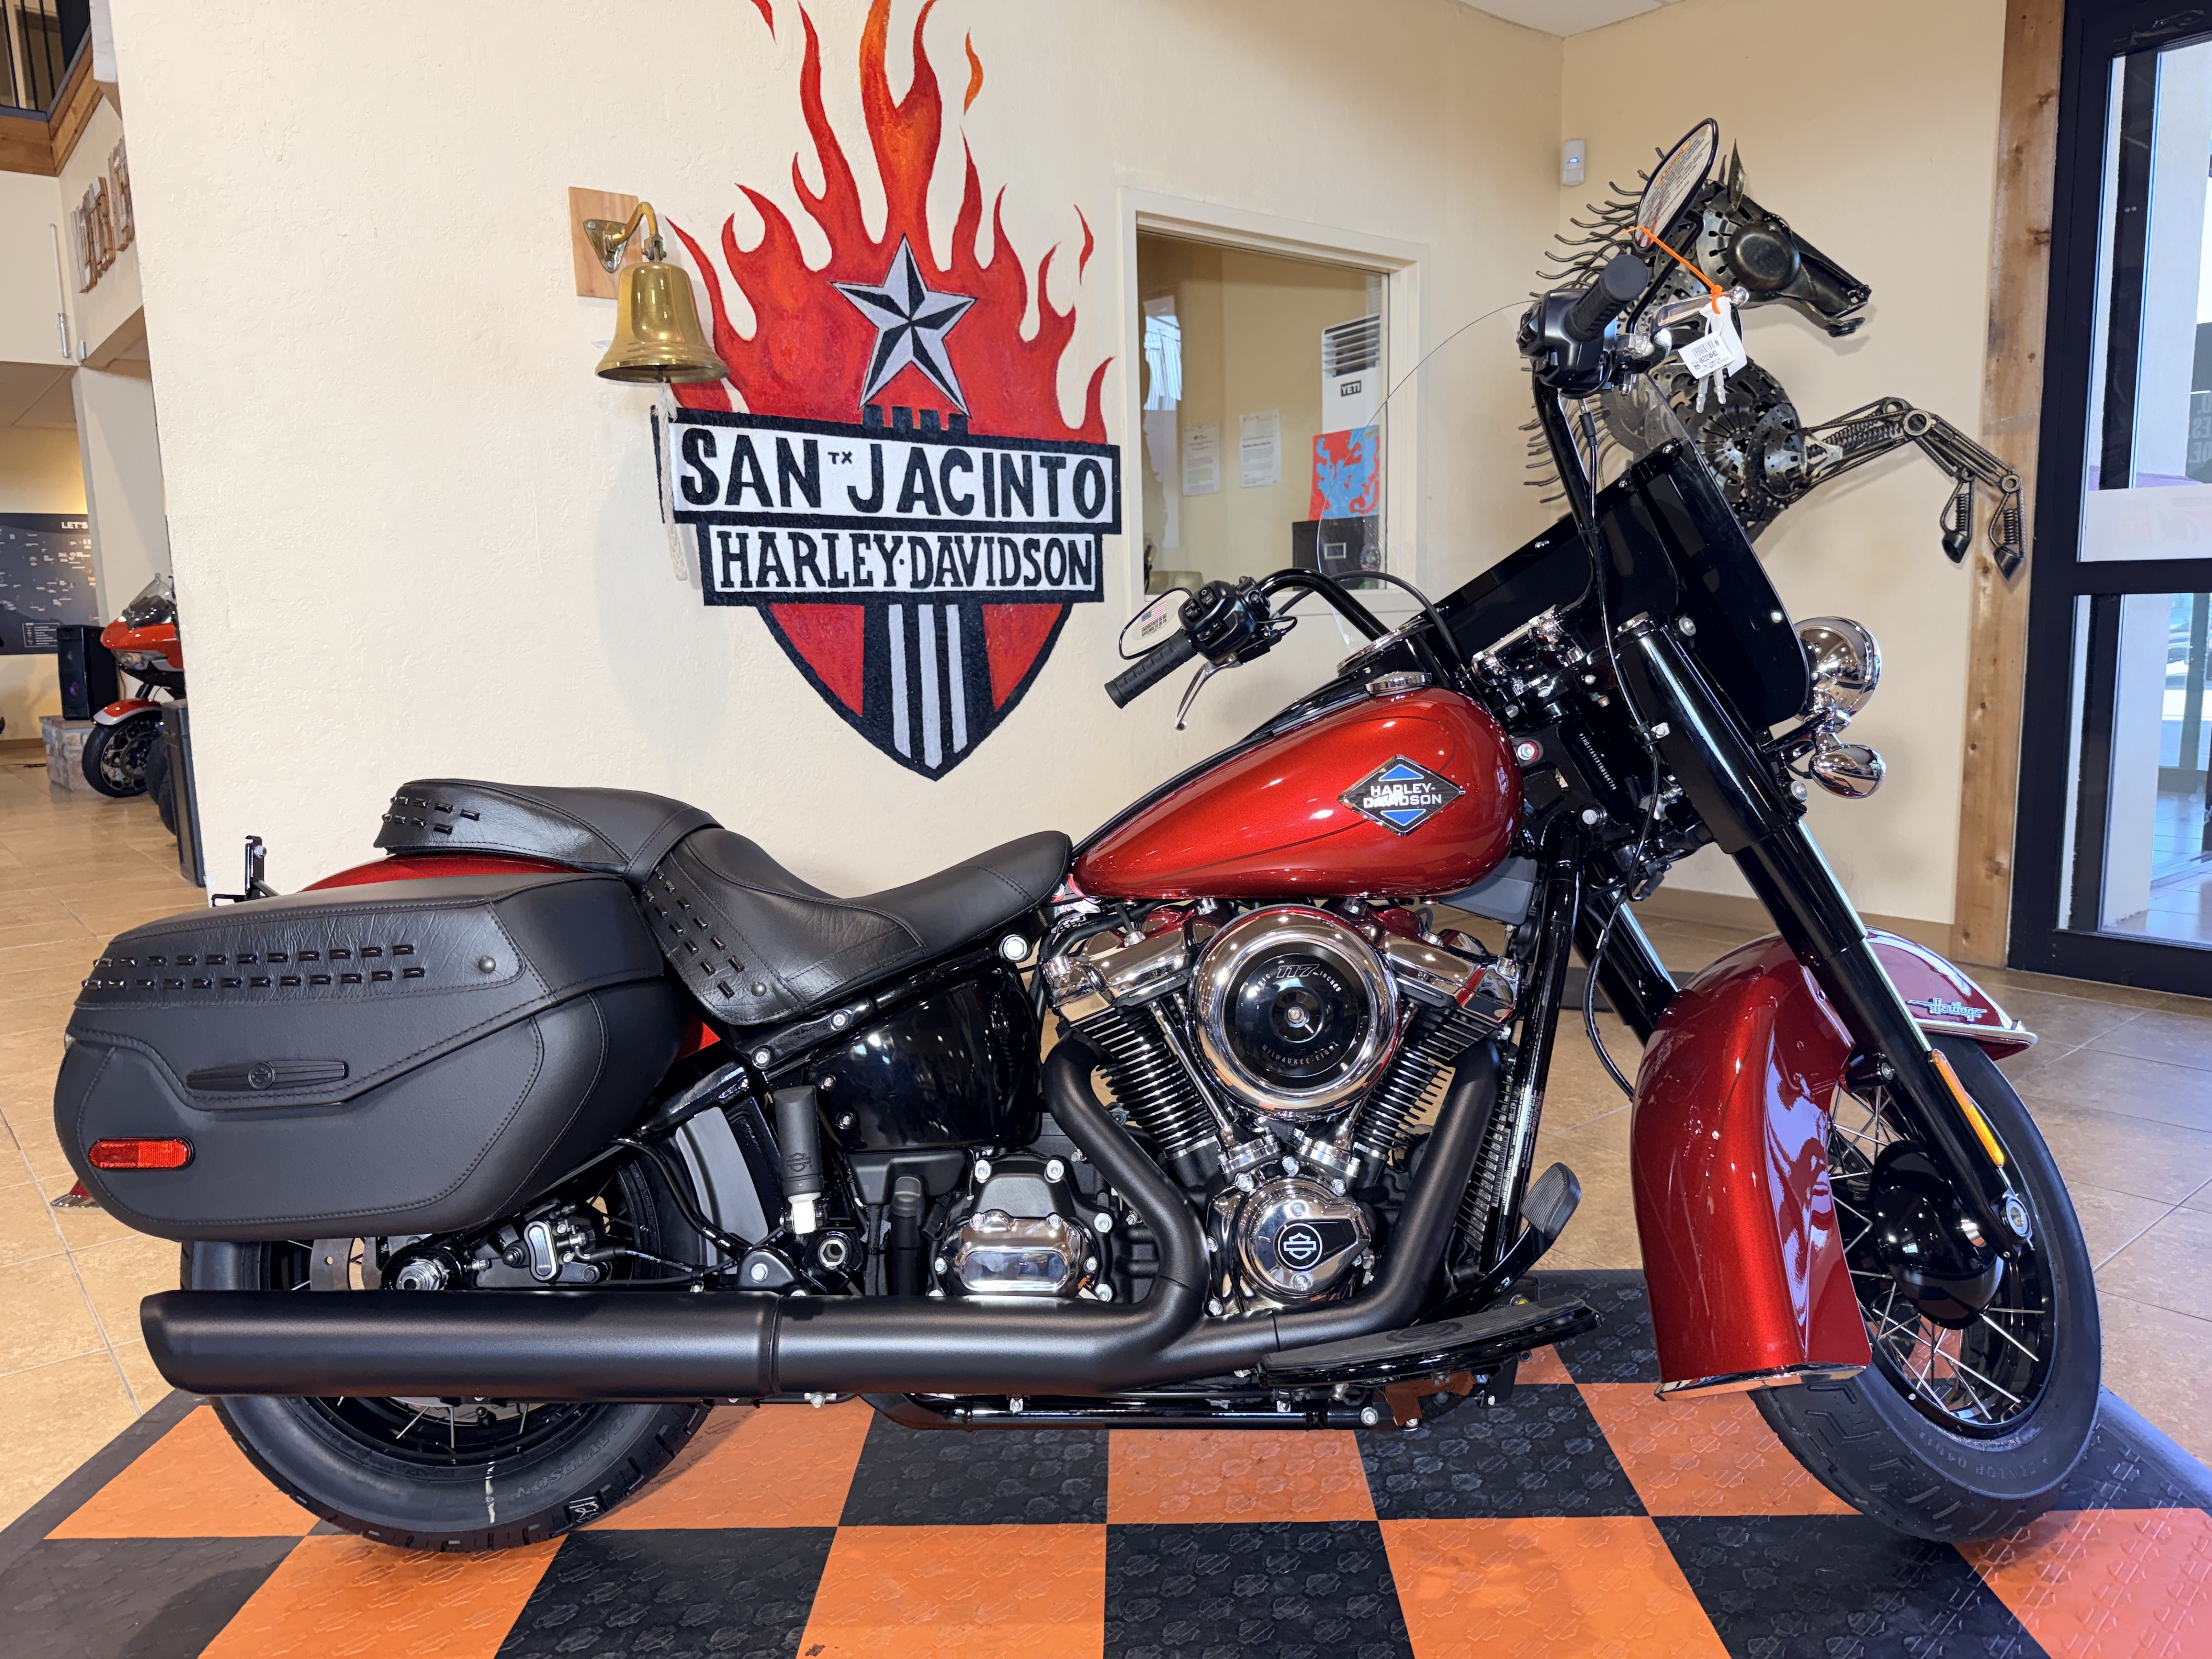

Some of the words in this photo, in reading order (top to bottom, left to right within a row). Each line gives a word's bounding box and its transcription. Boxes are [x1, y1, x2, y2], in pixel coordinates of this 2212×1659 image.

[1341, 382, 1360, 394] YETI
[680, 428, 821, 508] SAN
[828, 451, 853, 465] TX
[847, 444, 1107, 518] JACINTO
[1370, 782, 1436, 796] HARLEY-
[1363, 794, 1442, 808] DAVIDSON
[1276, 964, 1320, 978] 117
[1319, 970, 1341, 992] INCHES
[1929, 997, 1982, 1022] Heritage
[1975, 1462, 2037, 1479] DUNLOP
